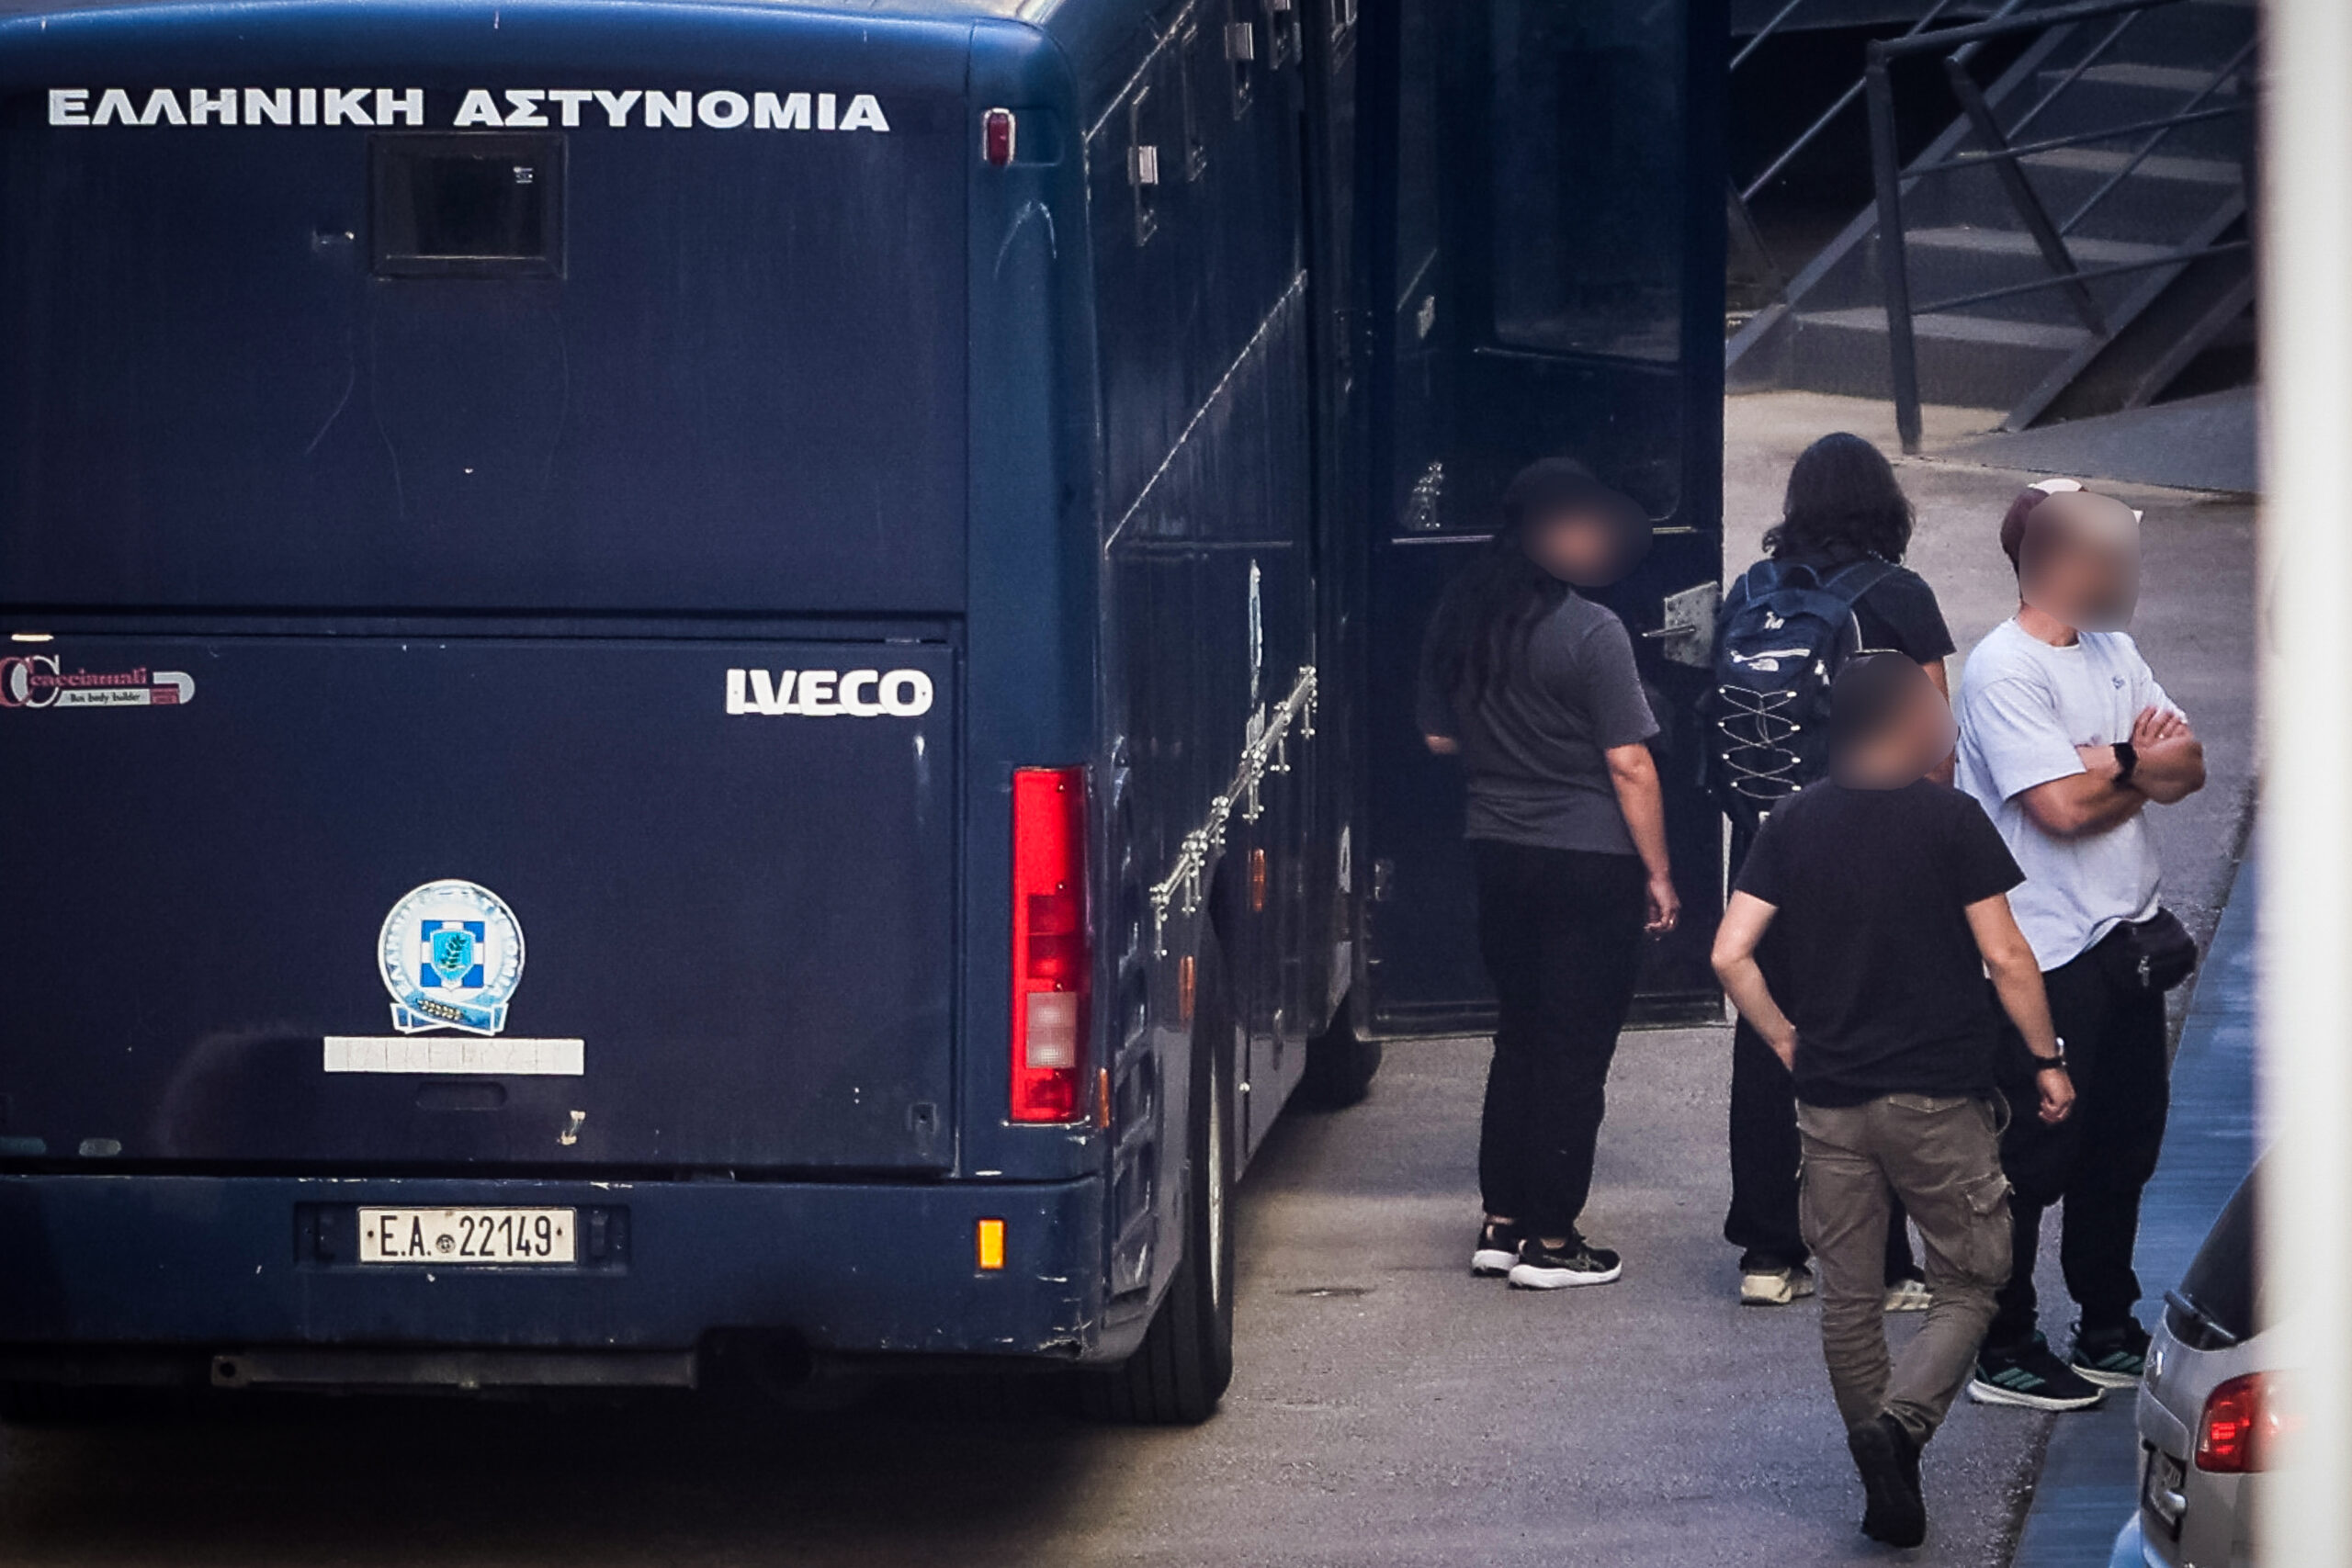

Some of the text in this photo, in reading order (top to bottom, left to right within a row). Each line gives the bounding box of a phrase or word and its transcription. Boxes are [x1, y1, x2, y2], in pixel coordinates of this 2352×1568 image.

[49, 87, 890, 132] ΕΛΛΗΝΙΚΗ ΑΣΤΥΝΟΜΙΑ
[726, 668, 933, 717] IVECO
[459, 1215, 551, 1256] 22149
